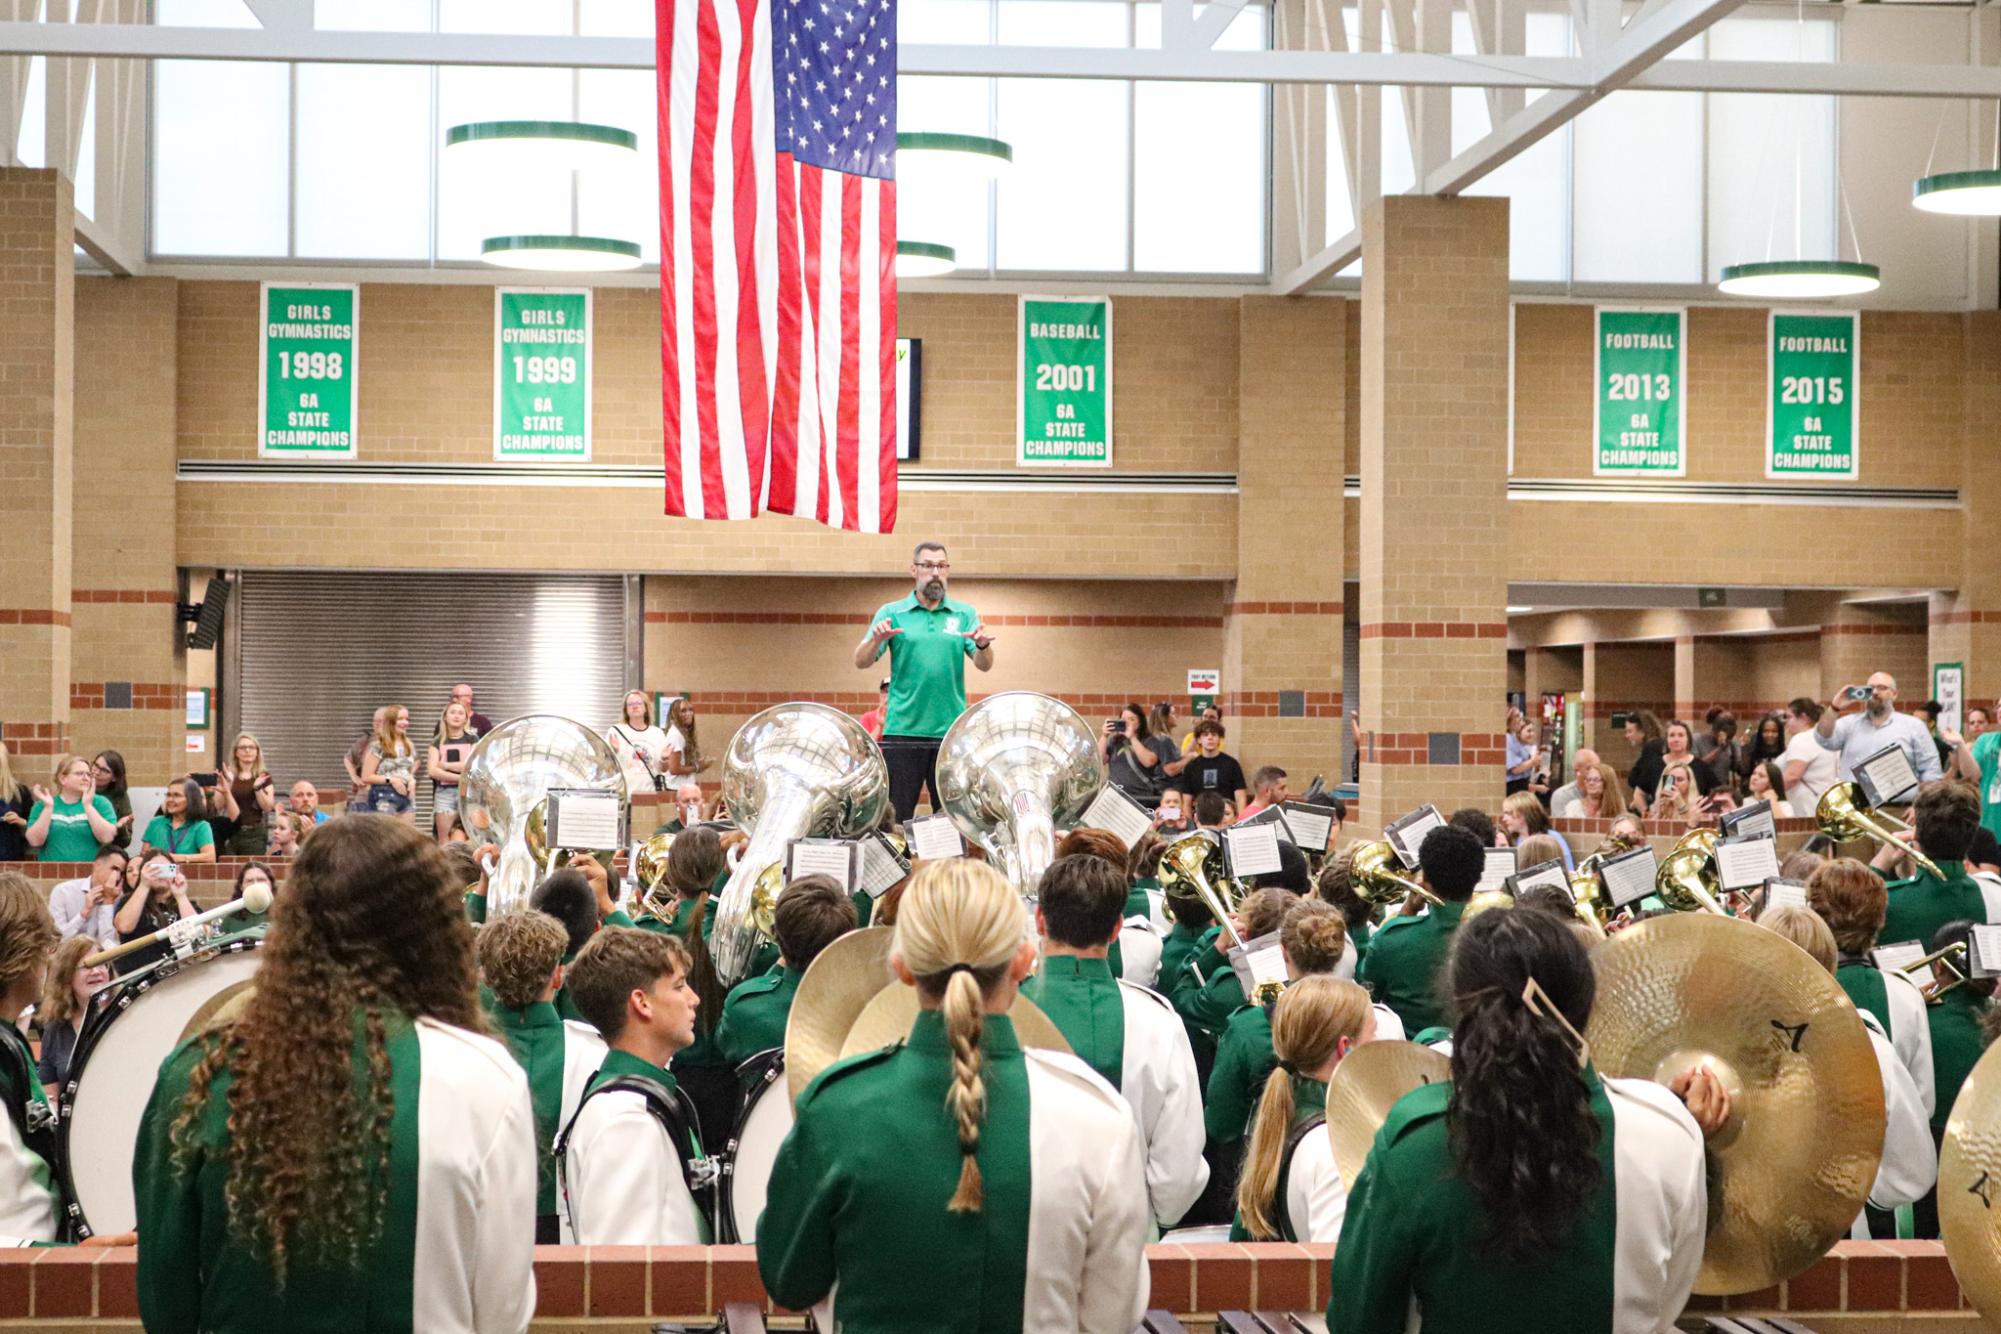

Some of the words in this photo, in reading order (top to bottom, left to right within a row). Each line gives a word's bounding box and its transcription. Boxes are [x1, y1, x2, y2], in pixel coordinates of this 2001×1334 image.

[288, 305, 331, 320] GIRLS
[521, 310, 565, 325] GIRLS
[268, 323, 352, 340] GYMNASTICS
[503, 328, 585, 344] GYMNASTICS
[1030, 323, 1100, 340] BASEBALL
[1606, 333, 1675, 350] FOOTBALL
[1779, 336, 1848, 353] FOOTBALL
[278, 351, 343, 380] 1998
[513, 356, 577, 384] 1999
[1036, 364, 1096, 392] 2001
[1608, 374, 1671, 401] 2013
[1781, 377, 1844, 404] 2015
[299, 394, 318, 408] 6A
[534, 398, 553, 413] 6A
[288, 412, 330, 427] STATE
[1056, 404, 1075, 420] 6A
[522, 416, 564, 432] STATE
[1631, 414, 1649, 429] 6A
[1803, 416, 1822, 431] 6A
[268, 430, 349, 446] CHAMPIONS
[1045, 422, 1086, 438] STATE
[502, 434, 583, 450] CHAMPIONS
[1620, 432, 1659, 447] STATE
[1793, 435, 1833, 450] STATE
[1026, 440, 1105, 456] CHAMPIONS
[1601, 450, 1678, 466] CHAMPIONS
[1774, 453, 1850, 469] CHAMPIONS
